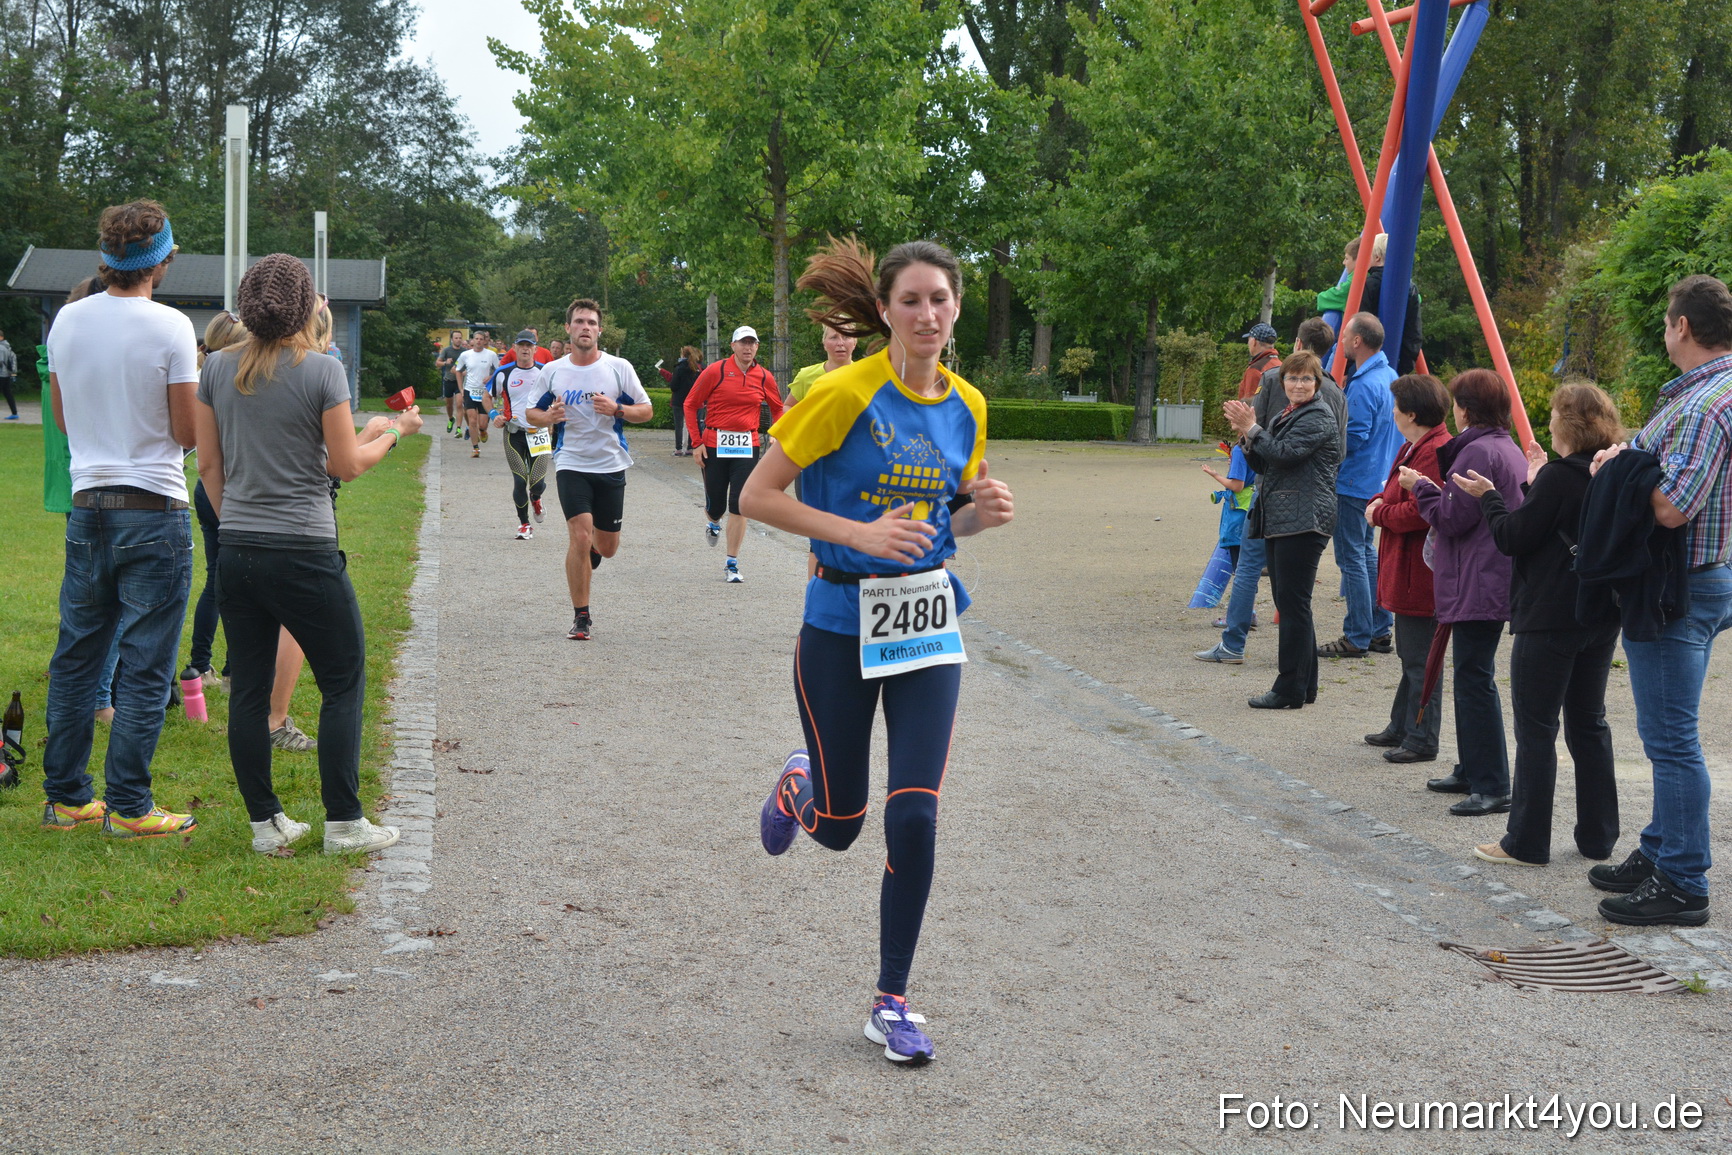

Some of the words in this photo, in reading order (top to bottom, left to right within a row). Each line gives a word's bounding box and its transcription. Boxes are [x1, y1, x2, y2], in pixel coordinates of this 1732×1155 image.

[720, 434, 749, 446] 2812
[862, 588, 898, 598] PARTL
[900, 581, 940, 596] Neumarkt
[871, 594, 947, 639] 2480
[864, 636, 869, 644] C
[880, 641, 944, 662] Katharina
